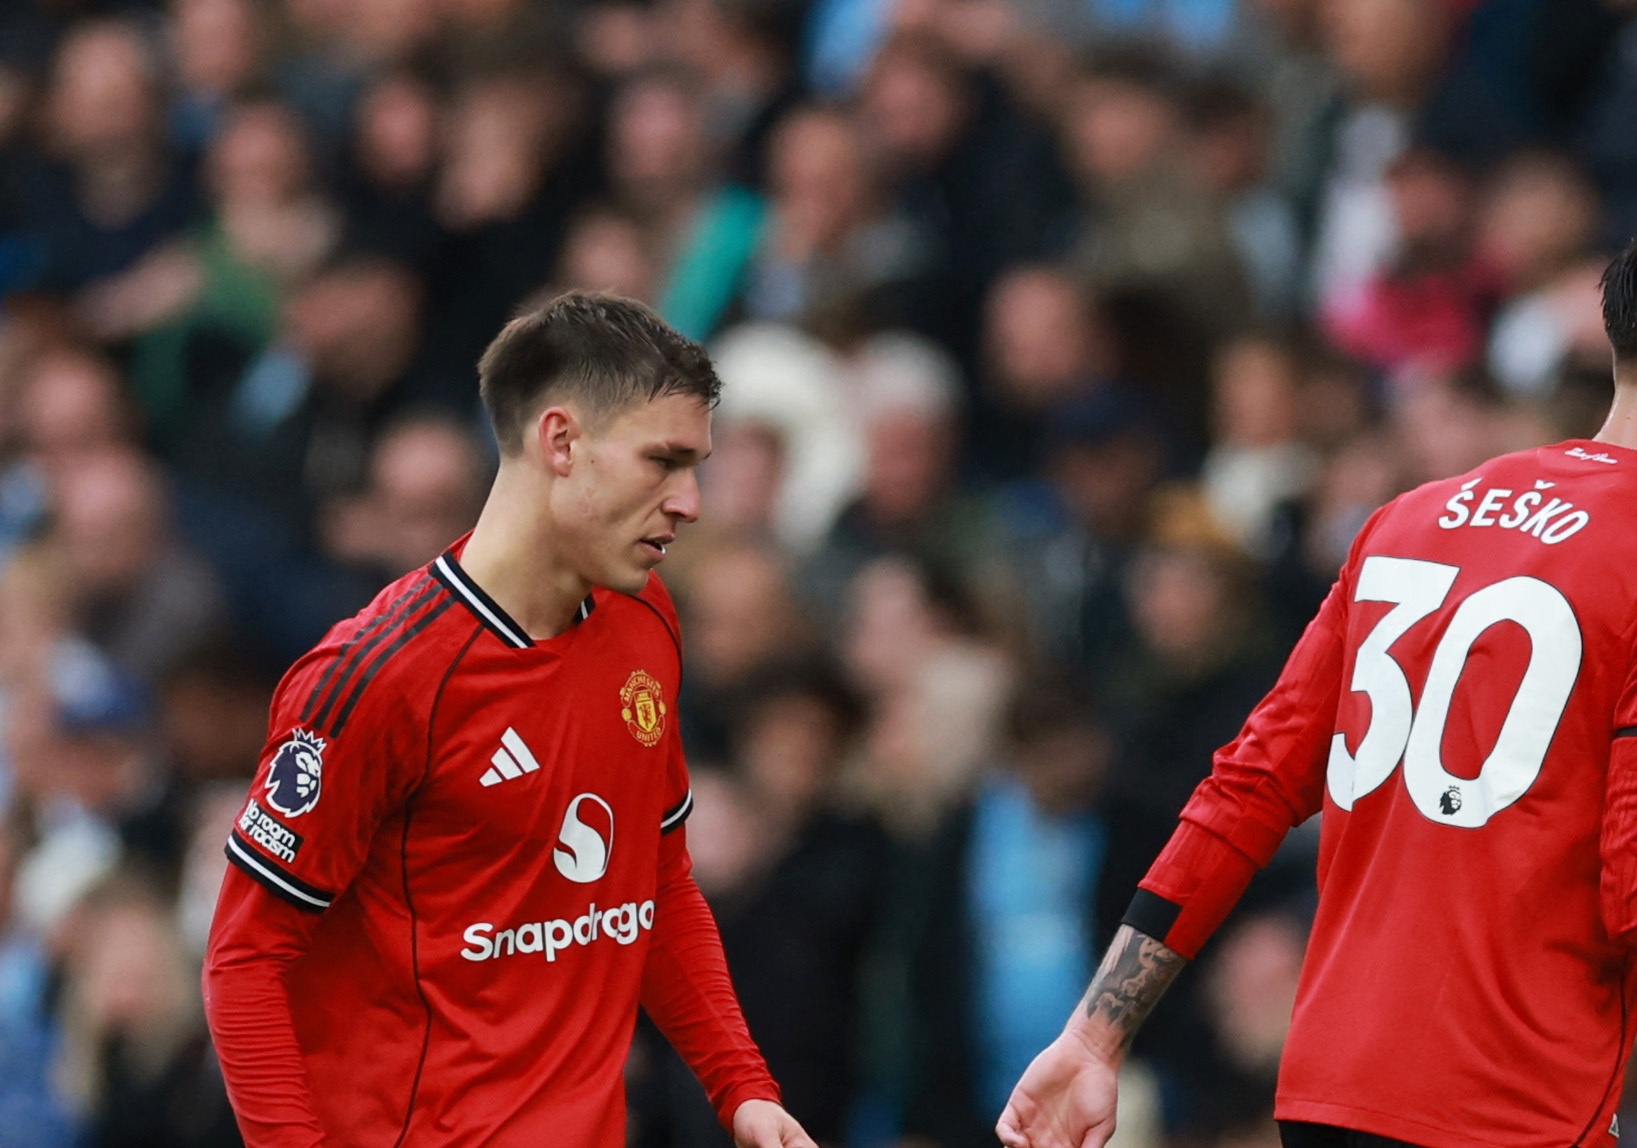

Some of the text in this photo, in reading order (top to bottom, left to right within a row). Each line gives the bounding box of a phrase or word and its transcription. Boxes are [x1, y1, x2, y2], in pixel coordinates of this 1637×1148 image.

[1326, 555, 1584, 829] 30
[636, 727, 661, 742] UNITED
[249, 824, 296, 863] racism
[257, 813, 296, 848] room
[460, 899, 654, 962] Snapdrago
